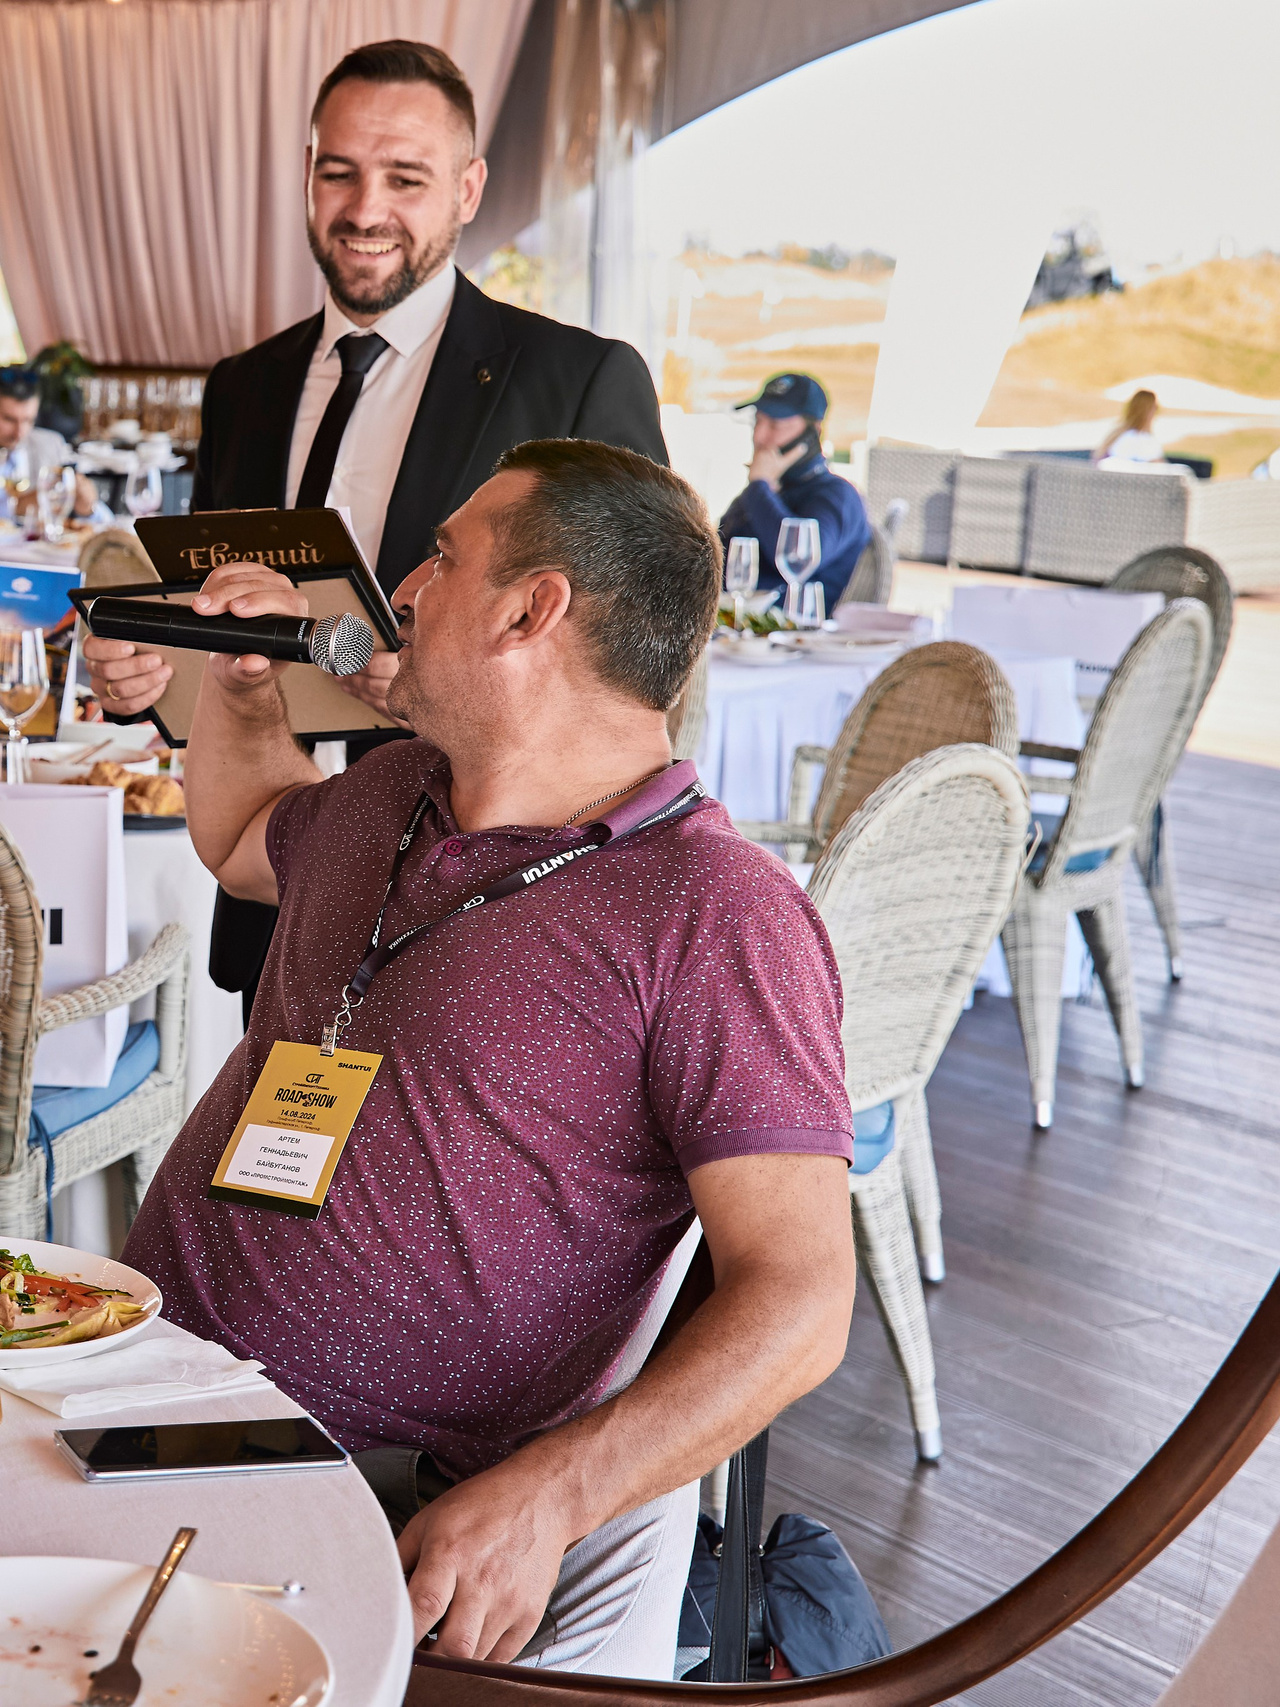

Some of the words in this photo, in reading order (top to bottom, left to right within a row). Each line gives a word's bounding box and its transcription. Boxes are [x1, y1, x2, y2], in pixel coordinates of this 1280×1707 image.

[180, 542, 325, 570] Евгений
[521, 844, 599, 885] SHANTUI
[337, 1062, 372, 1072] SHANTUI
[280, 1109, 316, 1120] 14.08.2024
[278, 1135, 301, 1144] АРТЕМ
[259, 1146, 309, 1160] ГЕННАДЬЕВИЧ
[256, 1160, 301, 1173] БАЙБУГАНОВ
